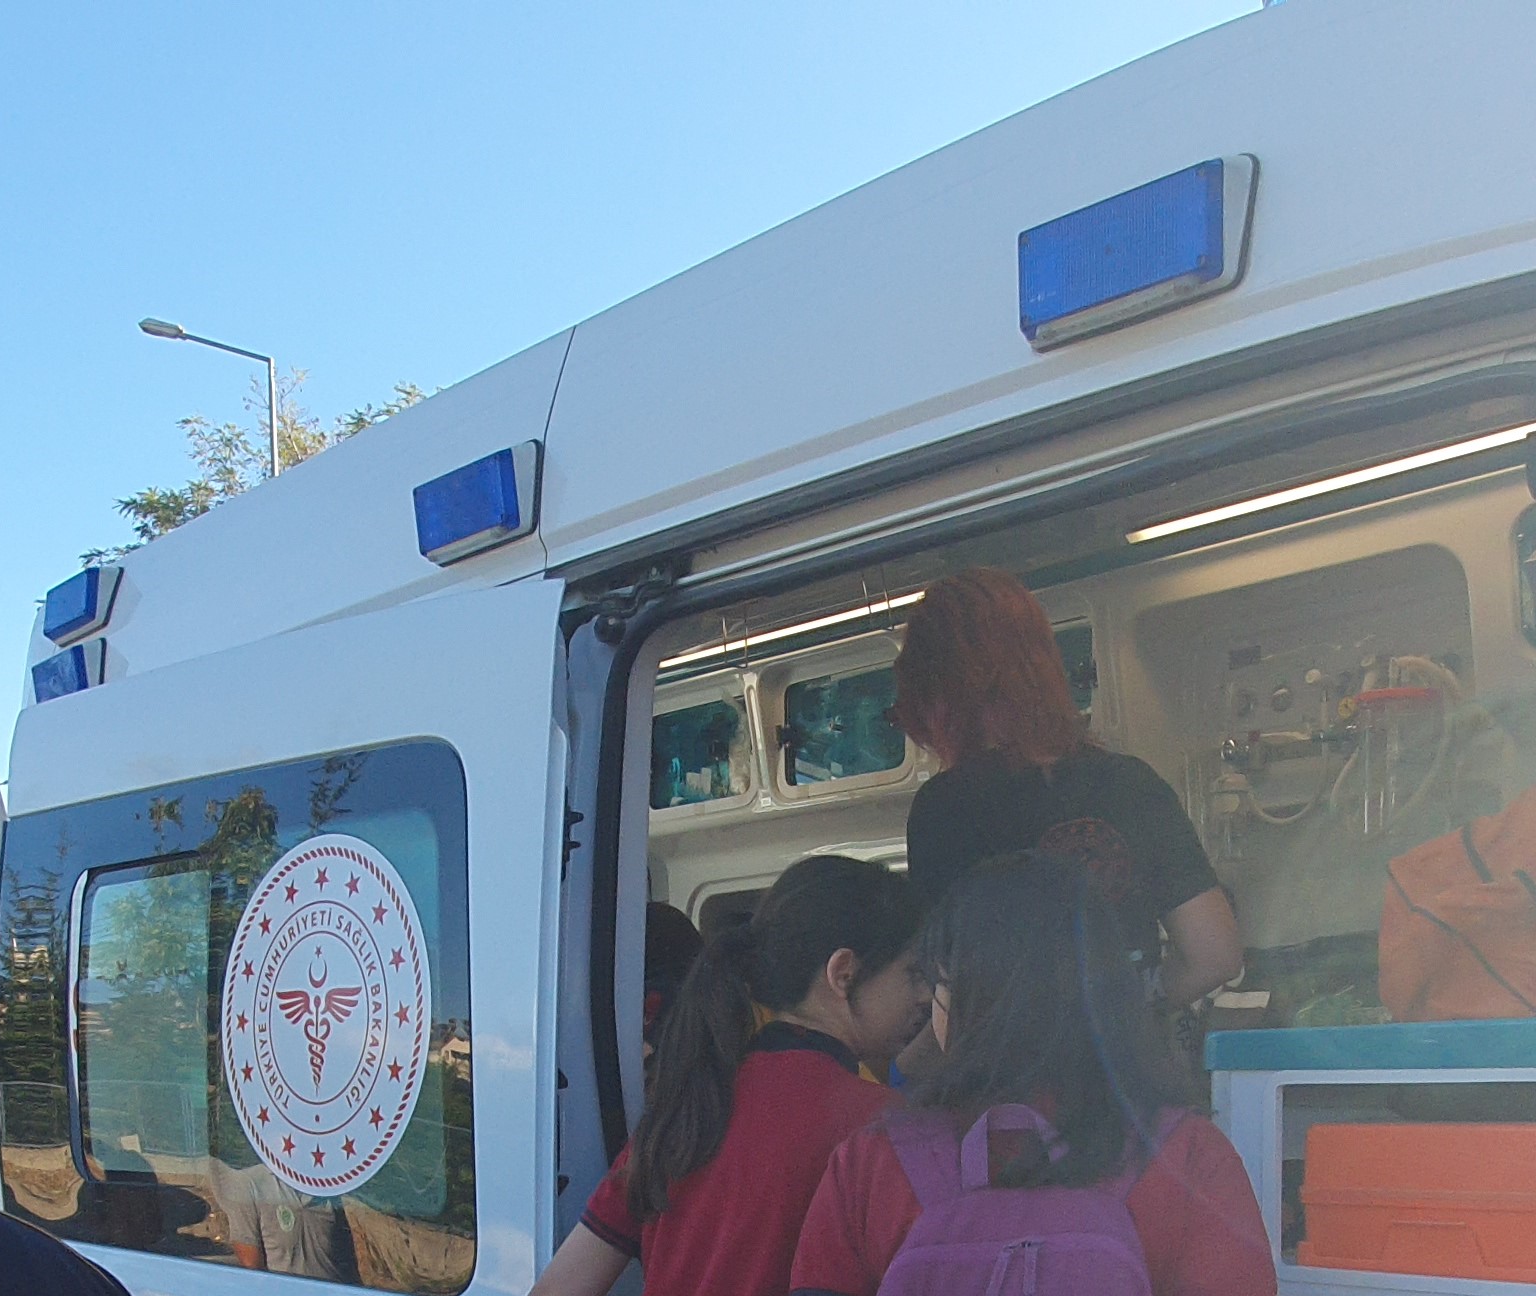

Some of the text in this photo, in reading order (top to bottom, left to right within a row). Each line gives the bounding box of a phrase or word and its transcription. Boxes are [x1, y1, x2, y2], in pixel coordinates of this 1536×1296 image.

[258, 907, 382, 1110] TÜRKİYE CUMHURİYETİ SAĞLIK BAKANLIĞI
